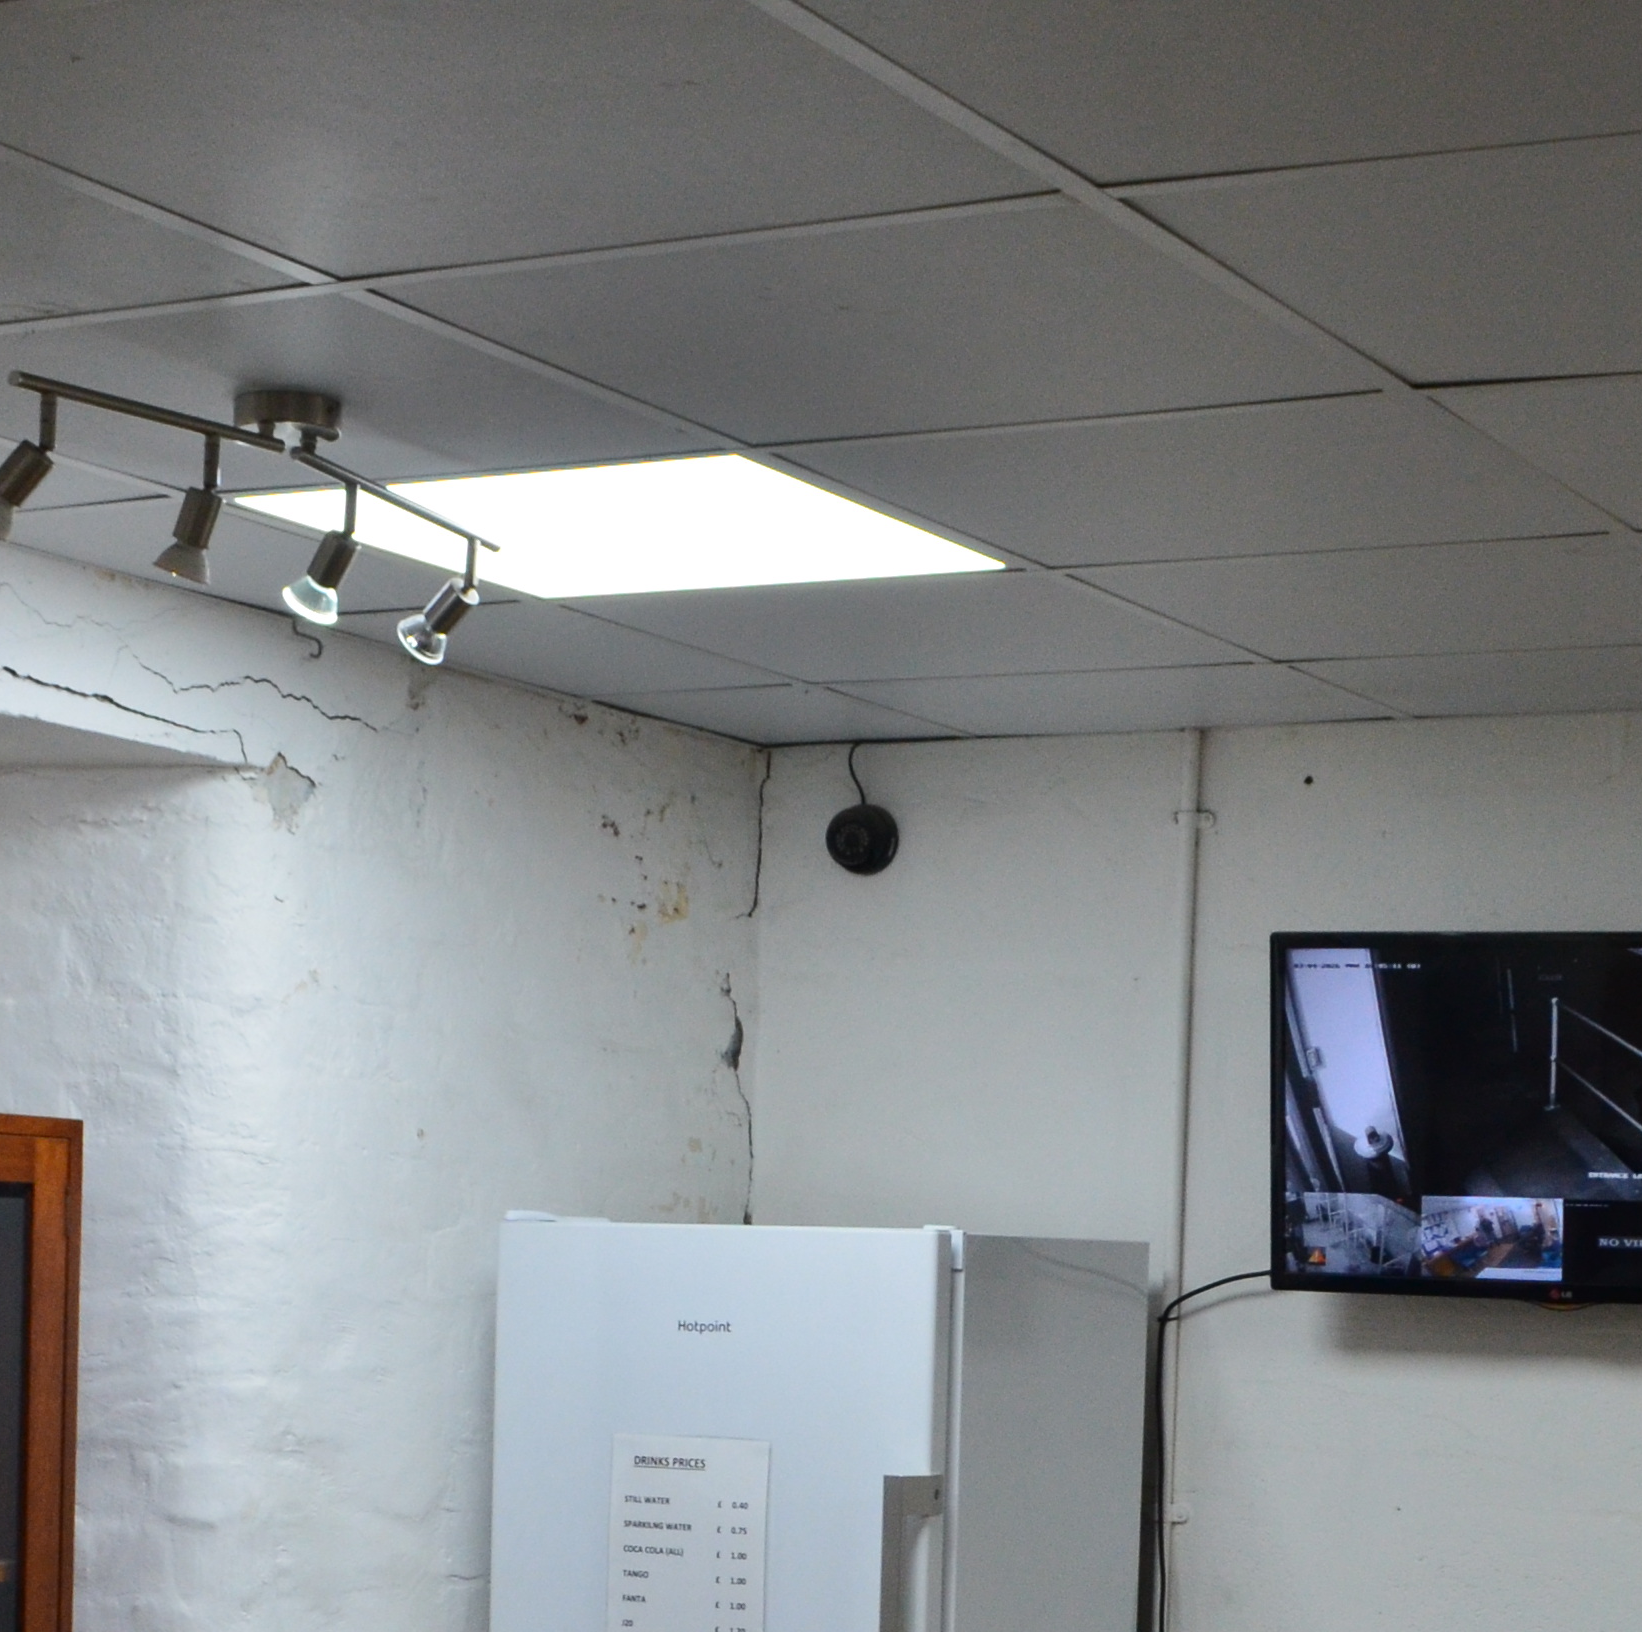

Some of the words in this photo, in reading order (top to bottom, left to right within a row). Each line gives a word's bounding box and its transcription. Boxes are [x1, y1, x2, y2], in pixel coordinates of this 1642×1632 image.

[1598, 1238, 1619, 1247] NO
[677, 1319, 732, 1335] Hotpoint
[633, 1455, 670, 1467] DRINKS
[672, 1457, 706, 1469] PRICES
[623, 1569, 649, 1579] TANGO
